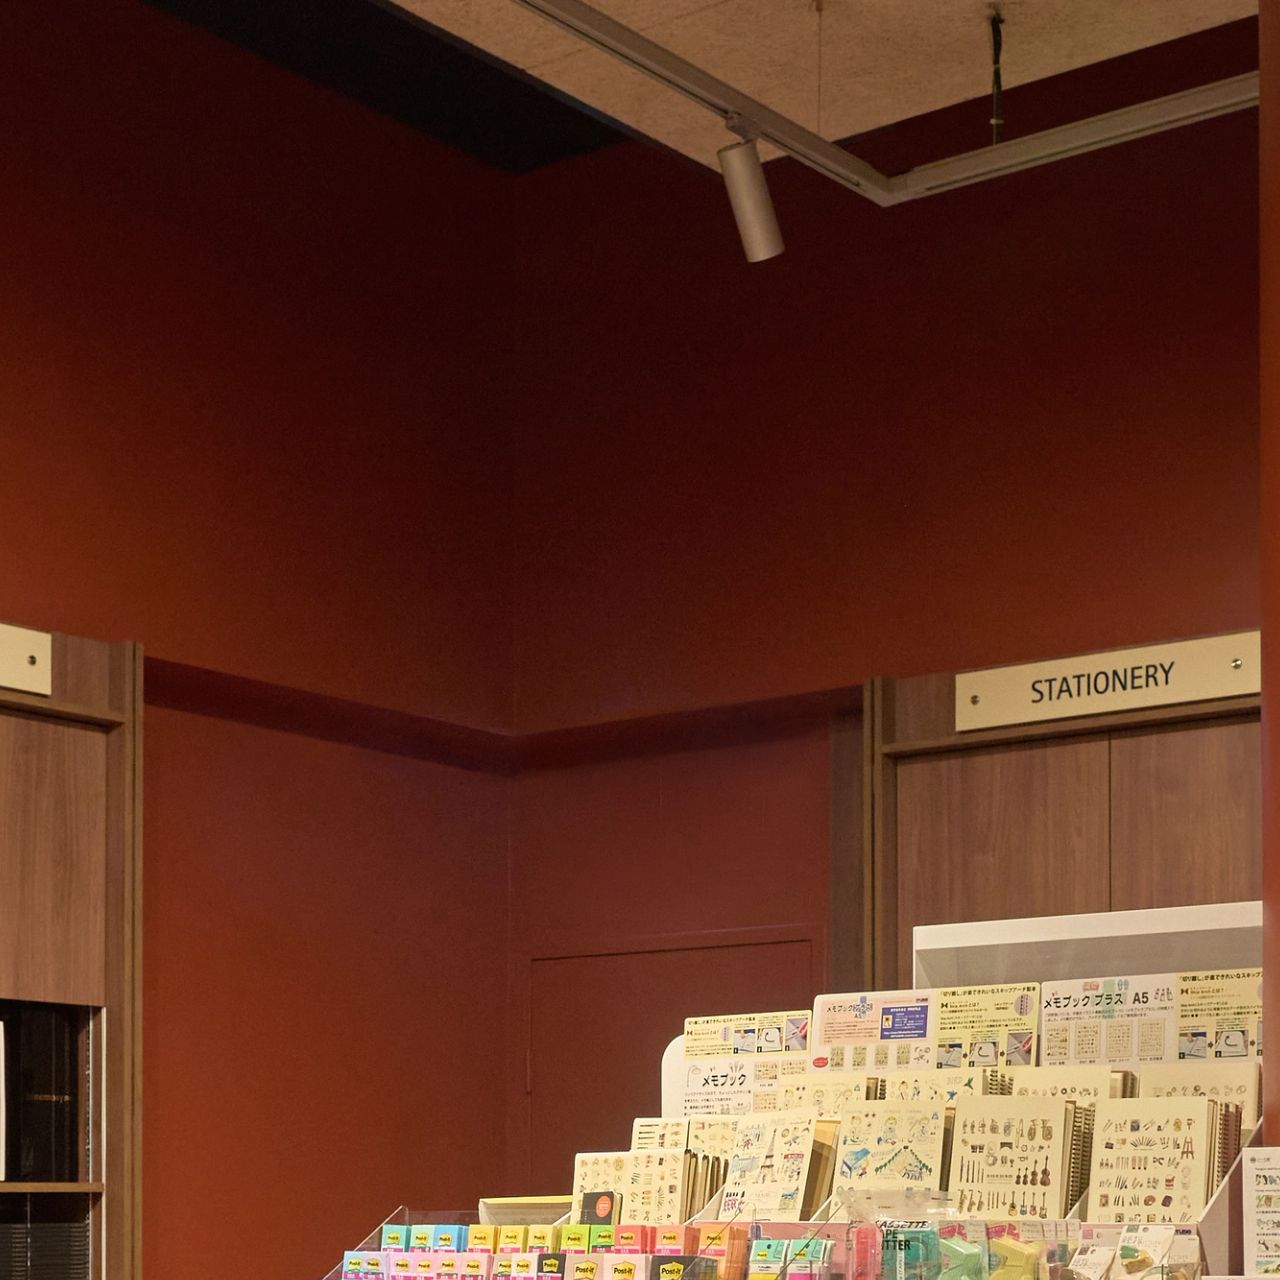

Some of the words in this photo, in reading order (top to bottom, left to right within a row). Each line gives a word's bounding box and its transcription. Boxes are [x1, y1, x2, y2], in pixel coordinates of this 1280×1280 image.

[1031, 661, 1175, 704] STATIONERY
[1044, 995, 1090, 1008] メモブック
[1095, 993, 1123, 1006] プラス
[1132, 992, 1149, 1004] A5
[702, 1073, 747, 1087] メモブック
[614, 1267, 633, 1275] Post-it
[661, 1267, 682, 1275] Post-it
